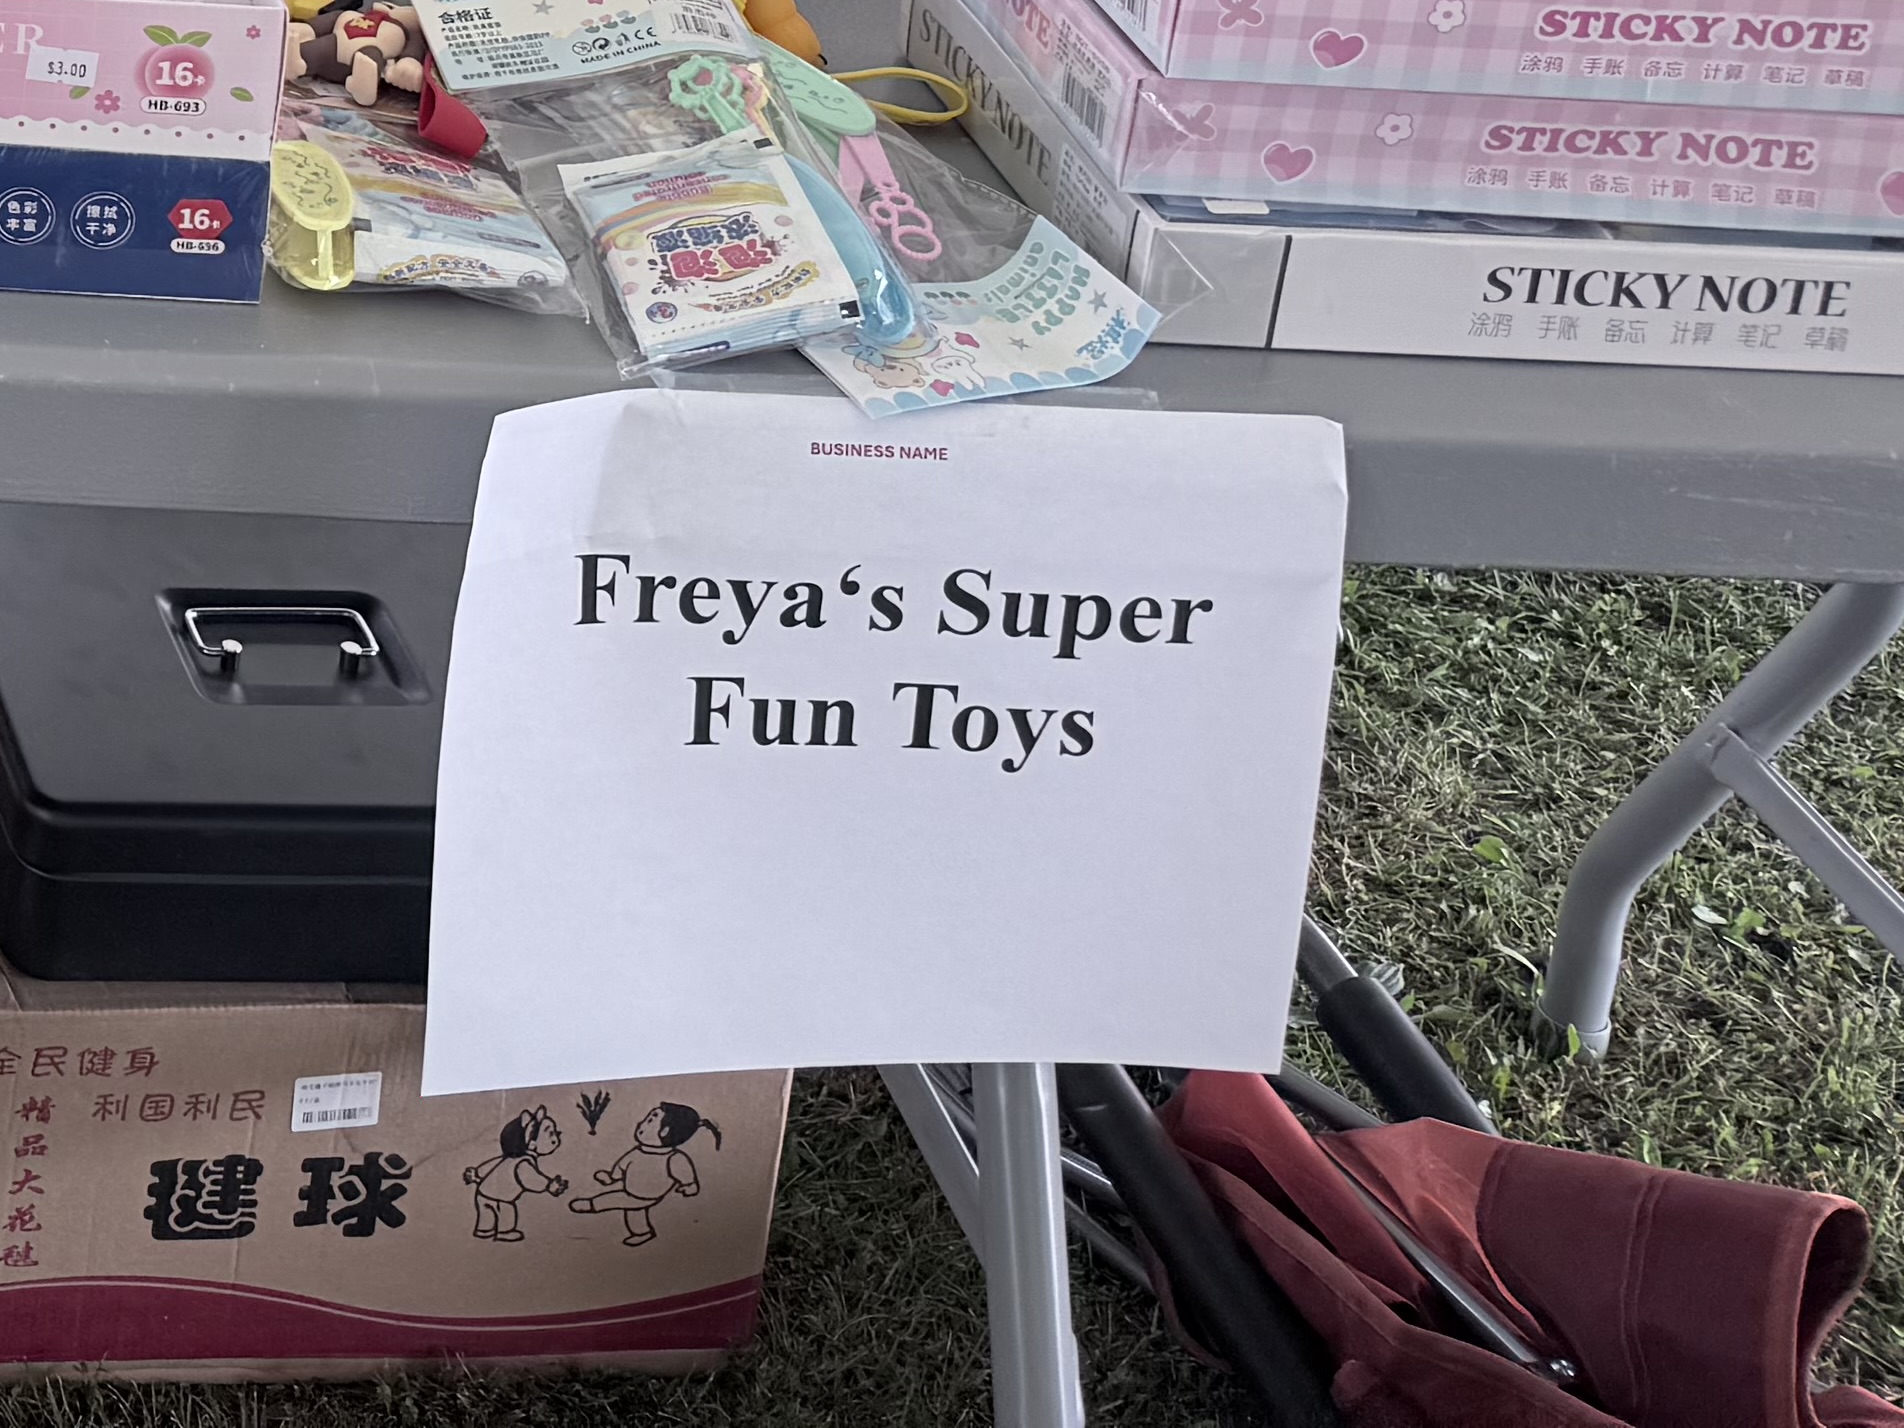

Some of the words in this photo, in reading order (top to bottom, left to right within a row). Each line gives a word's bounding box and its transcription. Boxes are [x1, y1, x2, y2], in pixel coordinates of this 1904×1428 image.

[438, 7, 494, 24] 合格证
[1538, 8, 1725, 45] STICKY
[1732, 17, 1870, 53] NOTE
[47, 60, 87, 79] $3.00
[580, 52, 611, 65] MADE
[612, 48, 625, 58] IN
[626, 41, 662, 56] CHINA
[1520, 54, 1564, 74] 涂鸦
[1642, 60, 1686, 80] 备忘
[1702, 63, 1745, 83] 计算
[1761, 65, 1806, 86] 笔记
[147, 99, 200, 113] HB-693
[921, 9, 993, 112] STICKY
[993, 102, 1053, 188] NOTE
[1483, 124, 1669, 157] STICKY
[1676, 132, 1816, 172] NOTE
[1464, 166, 1509, 187] 涂鸦
[1527, 170, 1569, 191] 手账
[1588, 173, 1632, 195] 备忘
[1650, 177, 1693, 198] 计算
[1710, 181, 1755, 205] 笔记
[669, 238, 775, 281] 泡泡
[1030, 263, 1091, 336] HAPPY
[1482, 265, 1692, 311] STICKY
[1692, 274, 1853, 318] NOTE
[1467, 311, 1513, 339] 涂鸦
[1536, 314, 1582, 342] 手账
[1603, 317, 1649, 344] 备忘
[1669, 320, 1717, 346] 计算
[1734, 322, 1783, 350] 笔记
[810, 441, 896, 459] BUSINESS
[898, 444, 949, 462] NAME
[937, 567, 1215, 660] Super
[683, 675, 859, 748] Fun
[891, 681, 1096, 775] Toys
[91, 1089, 267, 1123] 利国利民
[143, 1151, 414, 1241] 毽球
